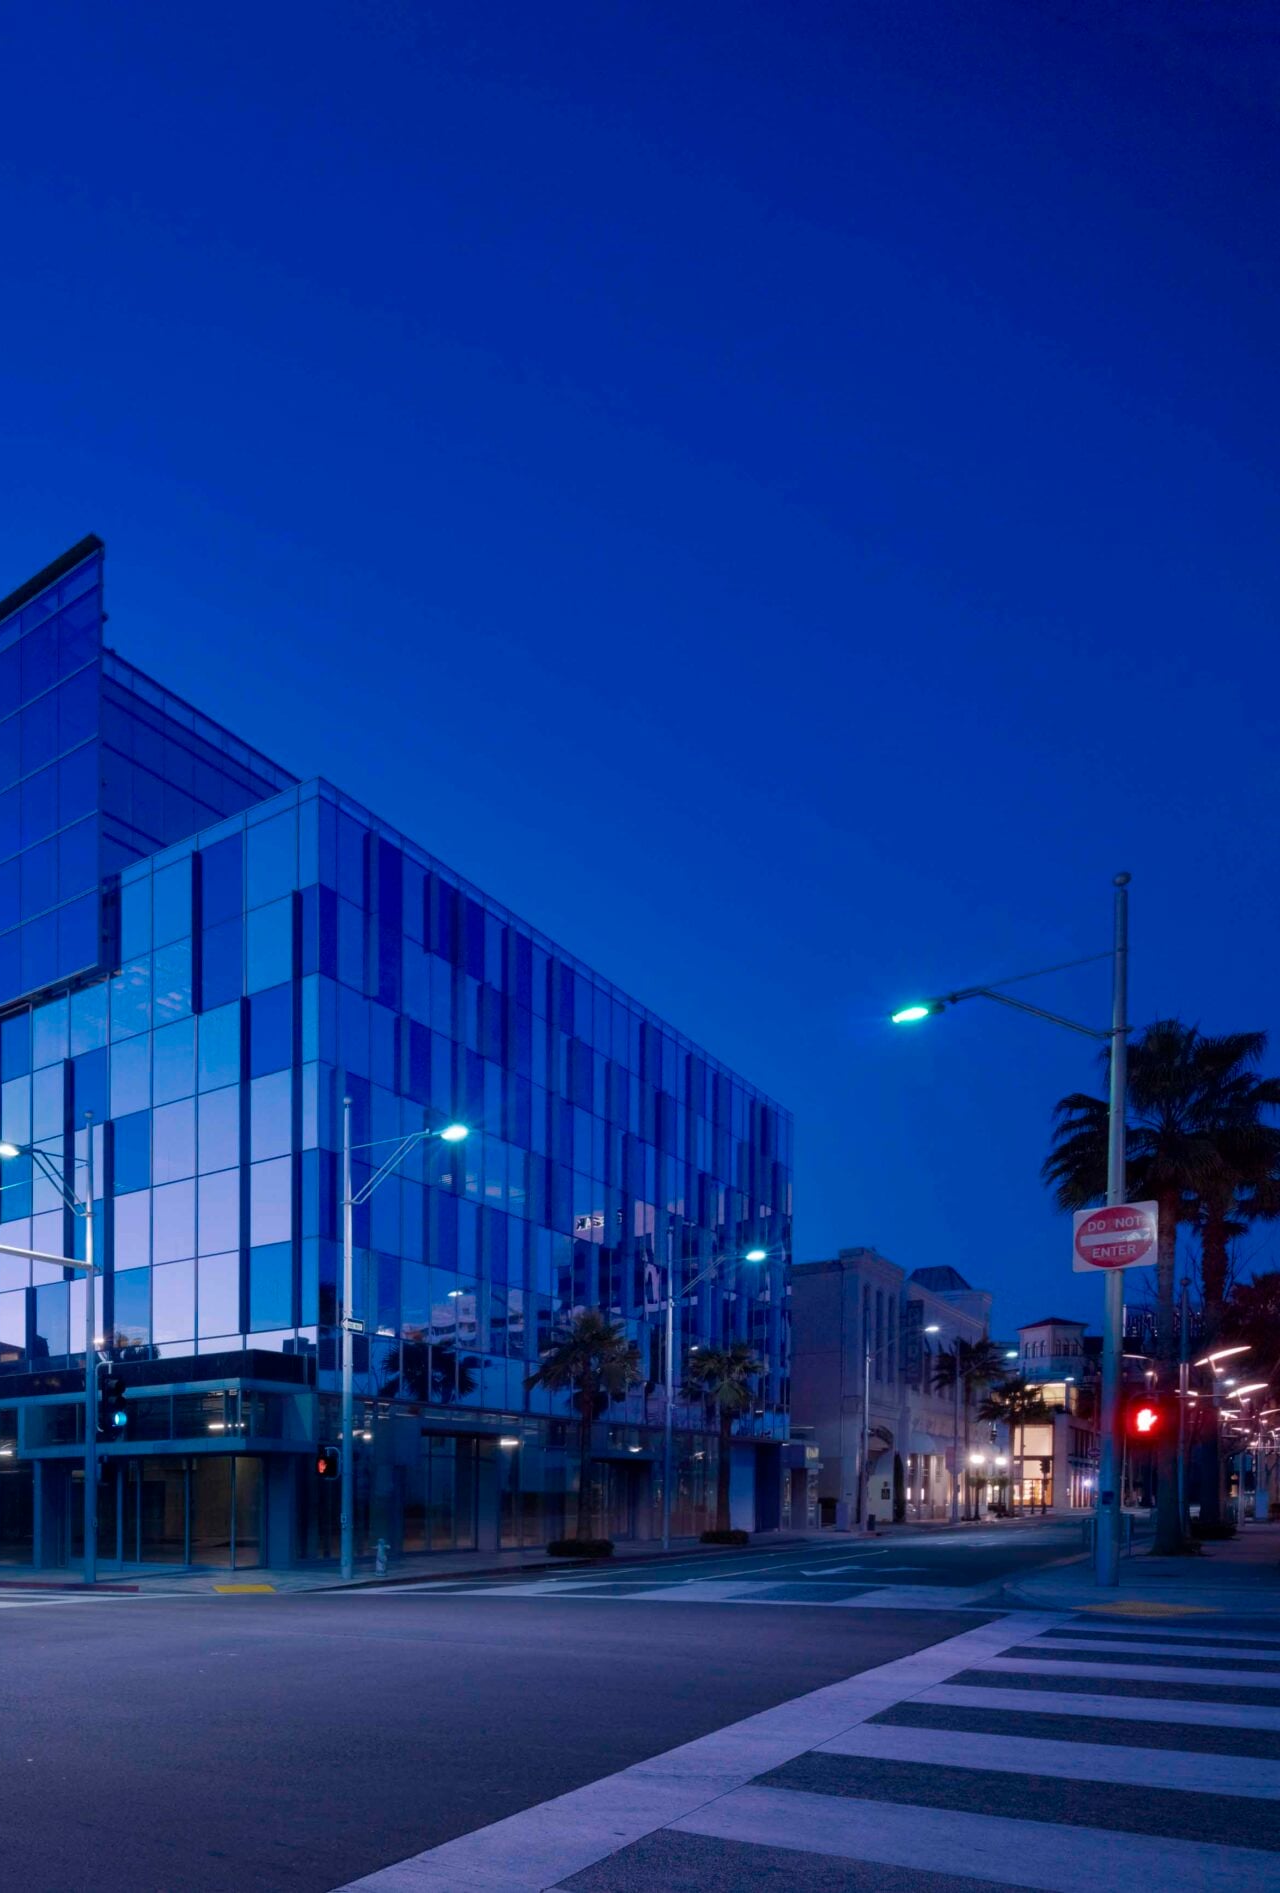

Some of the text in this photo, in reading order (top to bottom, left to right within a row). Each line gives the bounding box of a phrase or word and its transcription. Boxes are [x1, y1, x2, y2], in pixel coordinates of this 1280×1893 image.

[1087, 1215, 1142, 1232] DO NOT
[1092, 1244, 1136, 1258] ENTER
